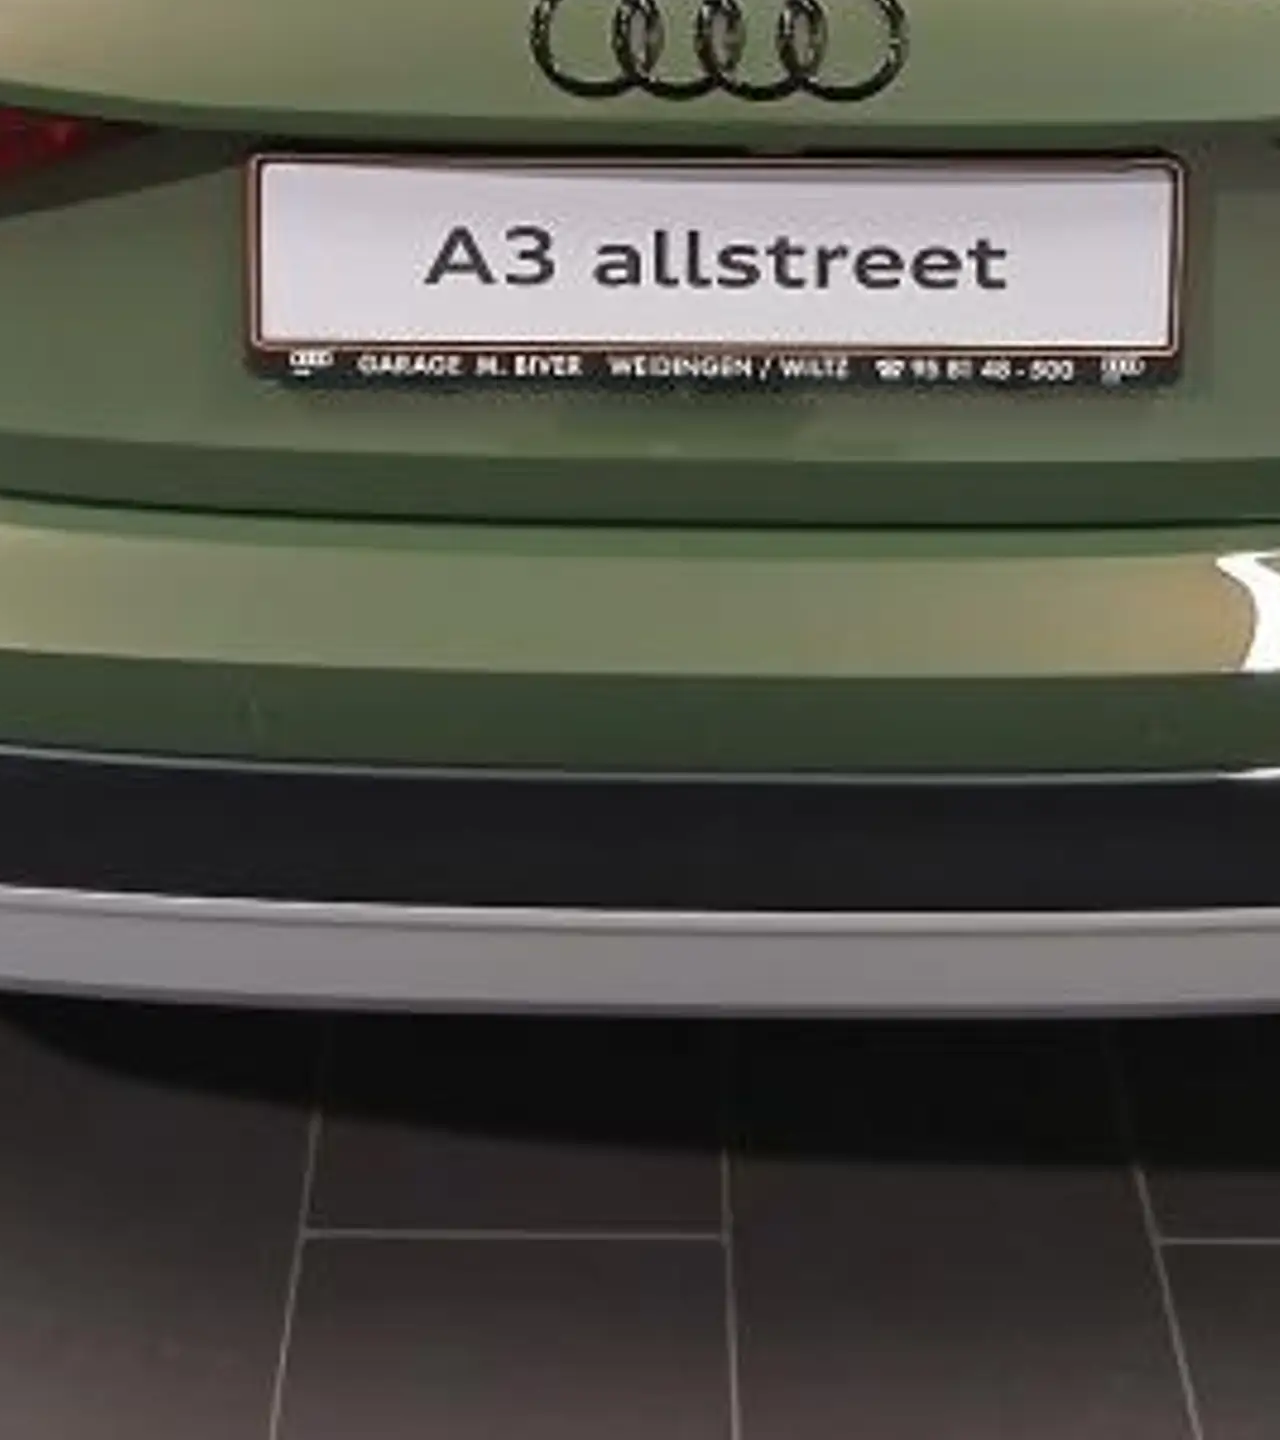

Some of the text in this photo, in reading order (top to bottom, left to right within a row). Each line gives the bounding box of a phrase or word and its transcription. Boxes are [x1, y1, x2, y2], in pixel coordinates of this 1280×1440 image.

[424, 225, 1008, 290] A3 allstreet
[357, 354, 463, 376] GARAGE
[606, 355, 753, 378] WEIDINGEN
[776, 357, 849, 380] WILTZ
